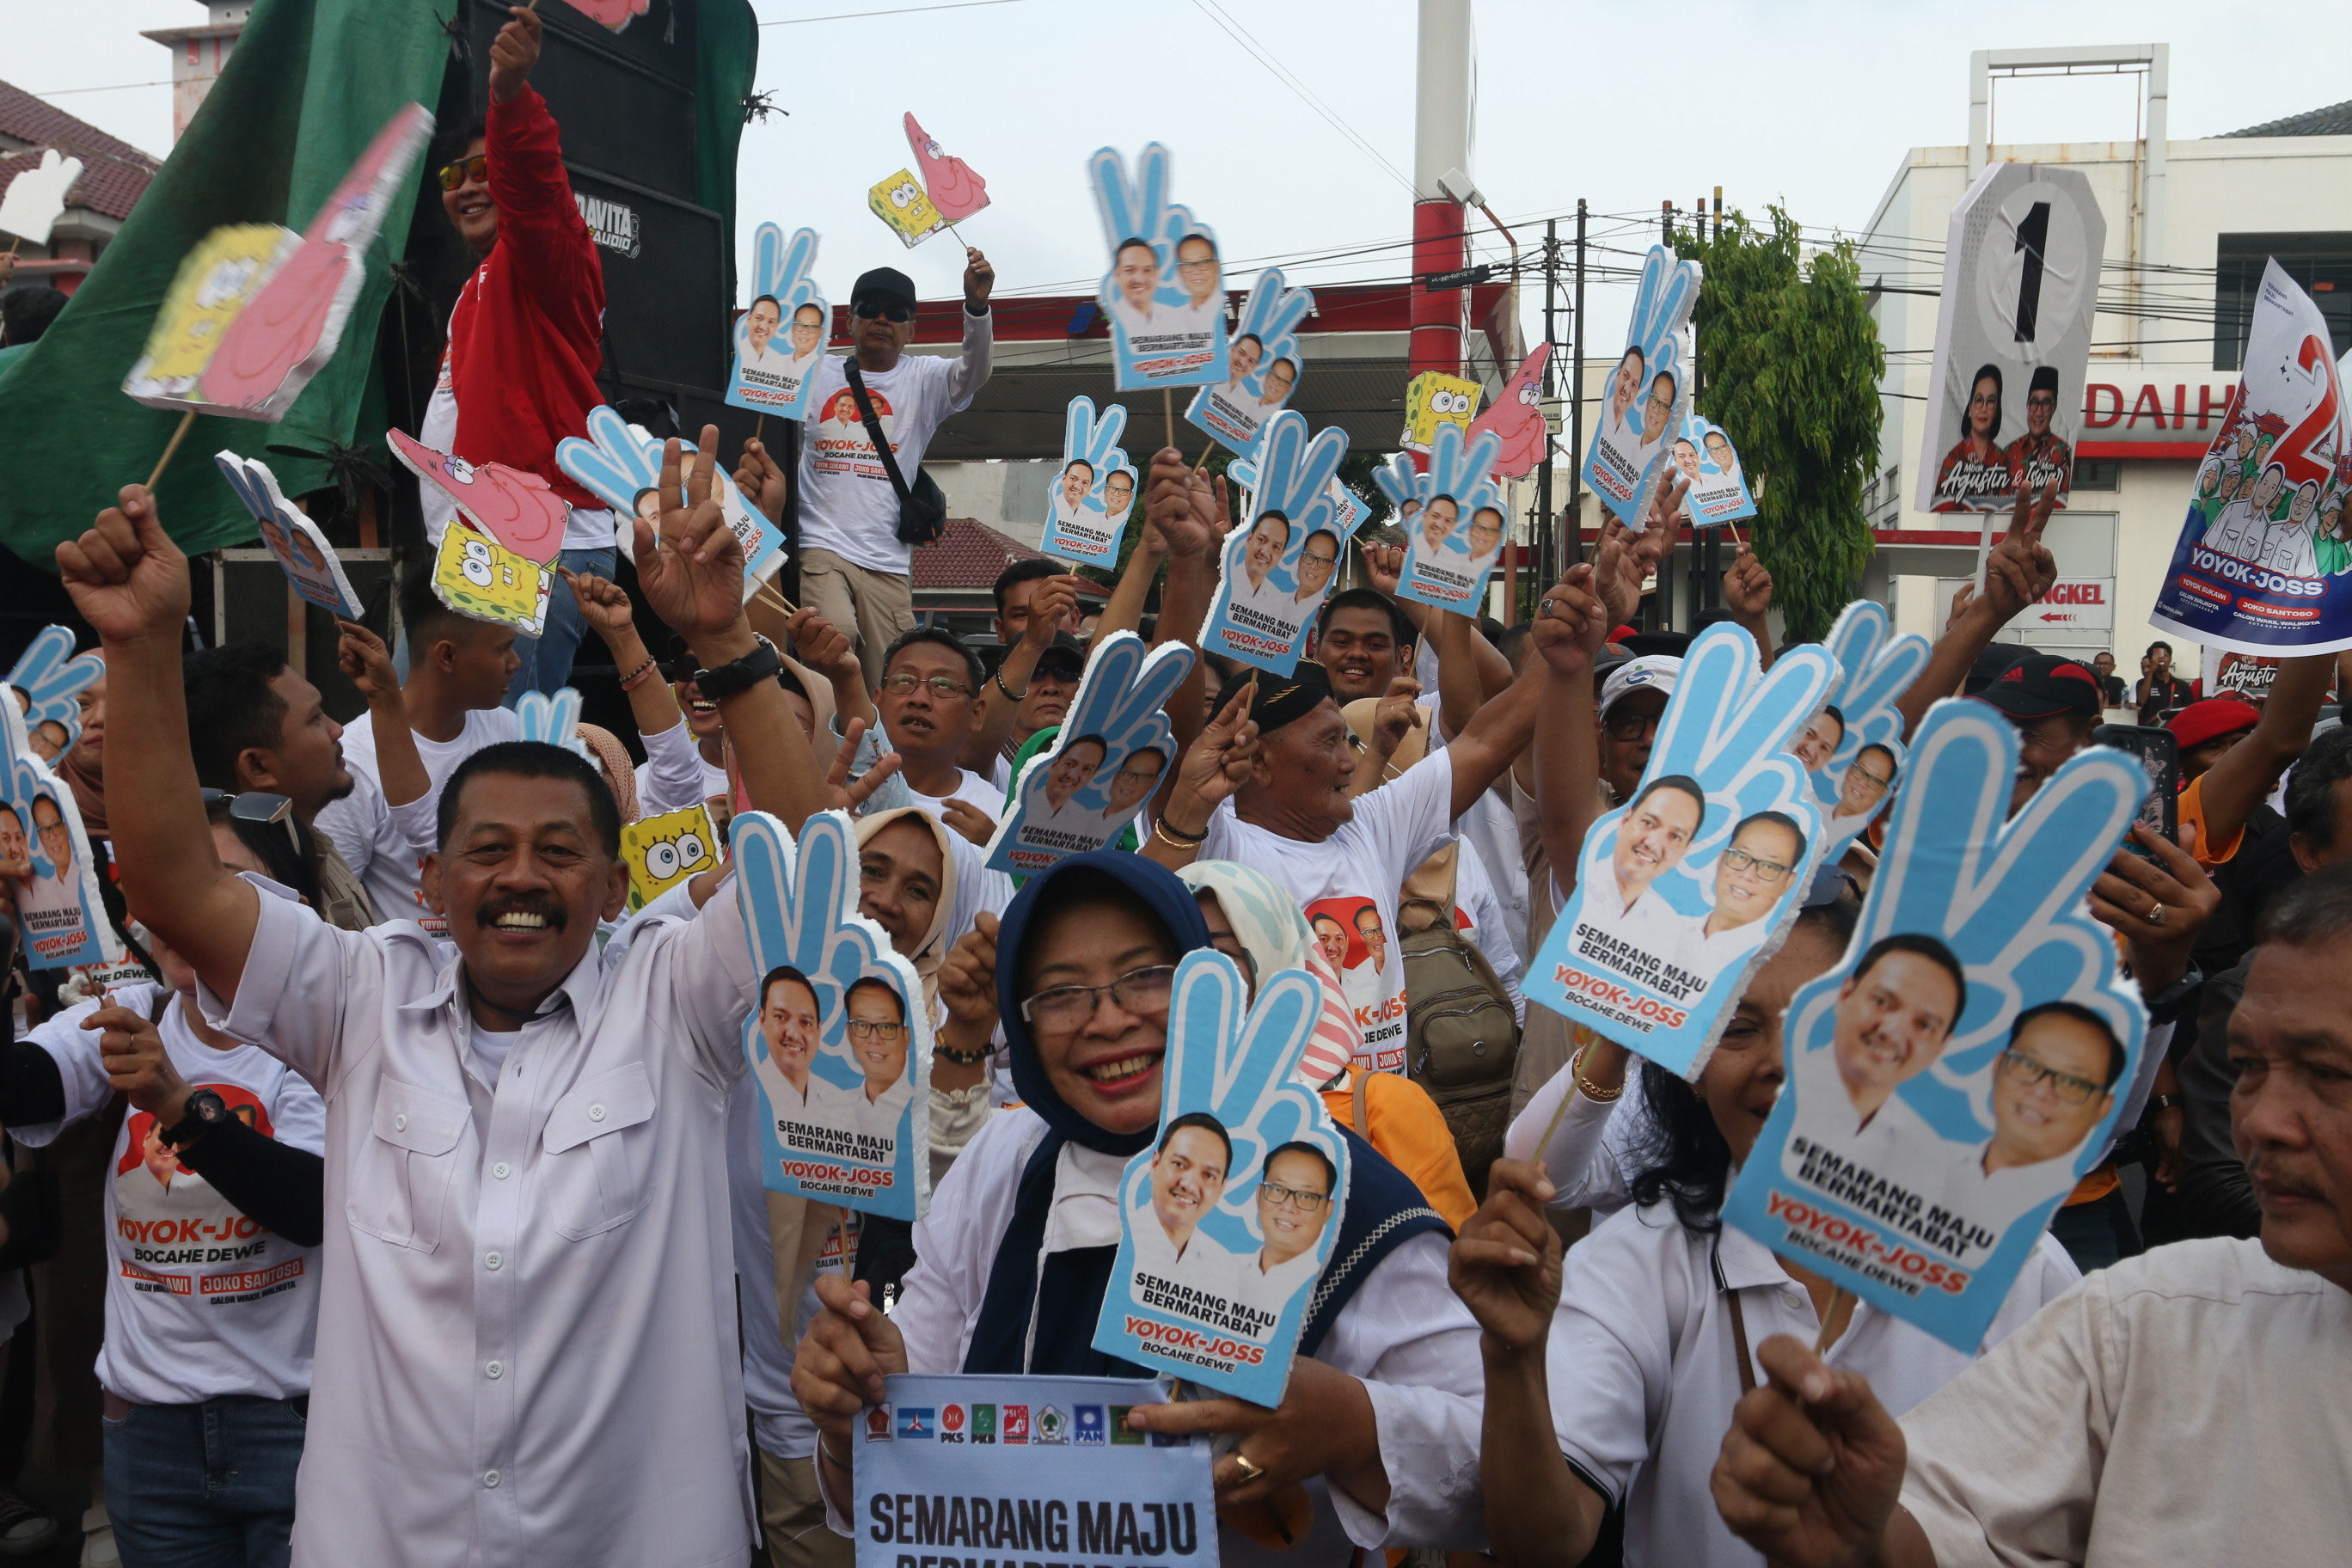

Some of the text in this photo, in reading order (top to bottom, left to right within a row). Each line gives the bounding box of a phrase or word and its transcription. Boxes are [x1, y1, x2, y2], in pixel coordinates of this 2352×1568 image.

[593, 230, 631, 250] AUDIO
[2014, 201, 2051, 343] 1
[2268, 282, 2288, 300] SEMARANG
[742, 367, 801, 385] SEMARANG MAJU
[744, 375, 795, 390] BERMARTABAT
[738, 387, 797, 402] YOYOK-JOSS
[2085, 383, 2236, 429] DAIH
[2266, 334, 2338, 486] 2
[814, 439, 898, 453] YOYOK-JOS
[1599, 437, 1641, 481] SEMARANG MAJU
[1600, 447, 1635, 486] BERMARTABAT
[1964, 462, 1984, 472] Mbak
[870, 467, 888, 475] SANTO
[1591, 462, 1633, 501] YOYOK-JOSS
[1595, 478, 1612, 495] BOCAHE
[1941, 461, 2010, 504] Agustin
[1694, 489, 1724, 499] SEMARANG
[1700, 491, 1739, 504] BERMARTABAT
[1701, 498, 1745, 515] YOYOK-JOSS
[1057, 520, 1113, 540] SEMARANG MAJU
[1060, 526, 1108, 544] BERMARTABAT
[747, 545, 761, 562] DEWE
[1053, 536, 1109, 554] YOYOK-JOSS
[1060, 546, 1082, 554] BOCAHE
[2192, 547, 2324, 596] YOYOK-JOSS
[1410, 579, 1471, 600] YOYOK-JOSS
[2034, 584, 2105, 604] NGKEL
[2183, 578, 2226, 600] YOYOK SUKAWI
[2178, 591, 2194, 601] CALON
[2193, 597, 2220, 611] WALIKOTA
[2242, 602, 2313, 617] JOKO SANTOSO
[1229, 603, 1299, 634] SEMARANG MAJU
[1232, 612, 1291, 640] BERMARTABAT
[2233, 611, 2255, 622] CALON
[2256, 617, 2279, 626] WAKIL
[1221, 628, 1290, 654] YOYOK-JOSS
[1228, 642, 1275, 659] BOCAHE DEWE
[2239, 663, 2257, 671] Mbak
[1021, 825, 1105, 846] SEMARANG MAJU
[1023, 835, 1093, 852] BERMARTABAT
[1008, 850, 1069, 863] YOYOK-
[24, 907, 82, 921] SEMARANG MAJU
[31, 916, 79, 930] BERMARTABAT
[33, 931, 88, 952] YOYOK-JOSS
[1576, 923, 1708, 992] SEMARANG MAJU
[113, 970, 152, 980] DEWE
[1578, 940, 1691, 1001] BERMARTABAT
[1553, 965, 1687, 1027] YOYOK-JOSS
[1354, 989, 1407, 1027] K-JOSS
[1565, 991, 1653, 1033] BOCAHE DEWE
[1376, 1023, 1402, 1041] DEWE
[1379, 1052, 1397, 1068] JOKO
[778, 1120, 894, 1151] SEMARANG MAJU
[787, 1135, 885, 1162] BERMARTABAT
[781, 1161, 894, 1186] YOYOK-JOSS
[800, 1180, 874, 1197] BOCAHE DEWE
[1791, 1136, 1995, 1249] SEMARANG MAJU
[1798, 1163, 1969, 1260] BERMARTABAT
[117, 1213, 272, 1244] YOYOK-JO
[134, 1240, 266, 1264] BOCAHE DEWE
[1767, 1191, 1969, 1295] YOYOK-JOSS
[816, 1257, 839, 1268] CALON
[1785, 1229, 1921, 1296] BOCAHE DEWE
[204, 1275, 241, 1291] JOKO
[244, 1261, 300, 1287] SANTOSO
[211, 1295, 236, 1305] CALON
[1135, 1272, 1276, 1327] SEMARANG MAJU
[1142, 1289, 1261, 1338] BERMARTABAT
[1125, 1316, 1265, 1364] YOYOK-JOSS
[1141, 1341, 1235, 1373] BOCAHE DEWE
[941, 1433, 964, 1443] PKS
[971, 1434, 995, 1444] PKB
[1075, 1431, 1103, 1441] PAN
[870, 1492, 1197, 1556] SEMARANG MAJU
